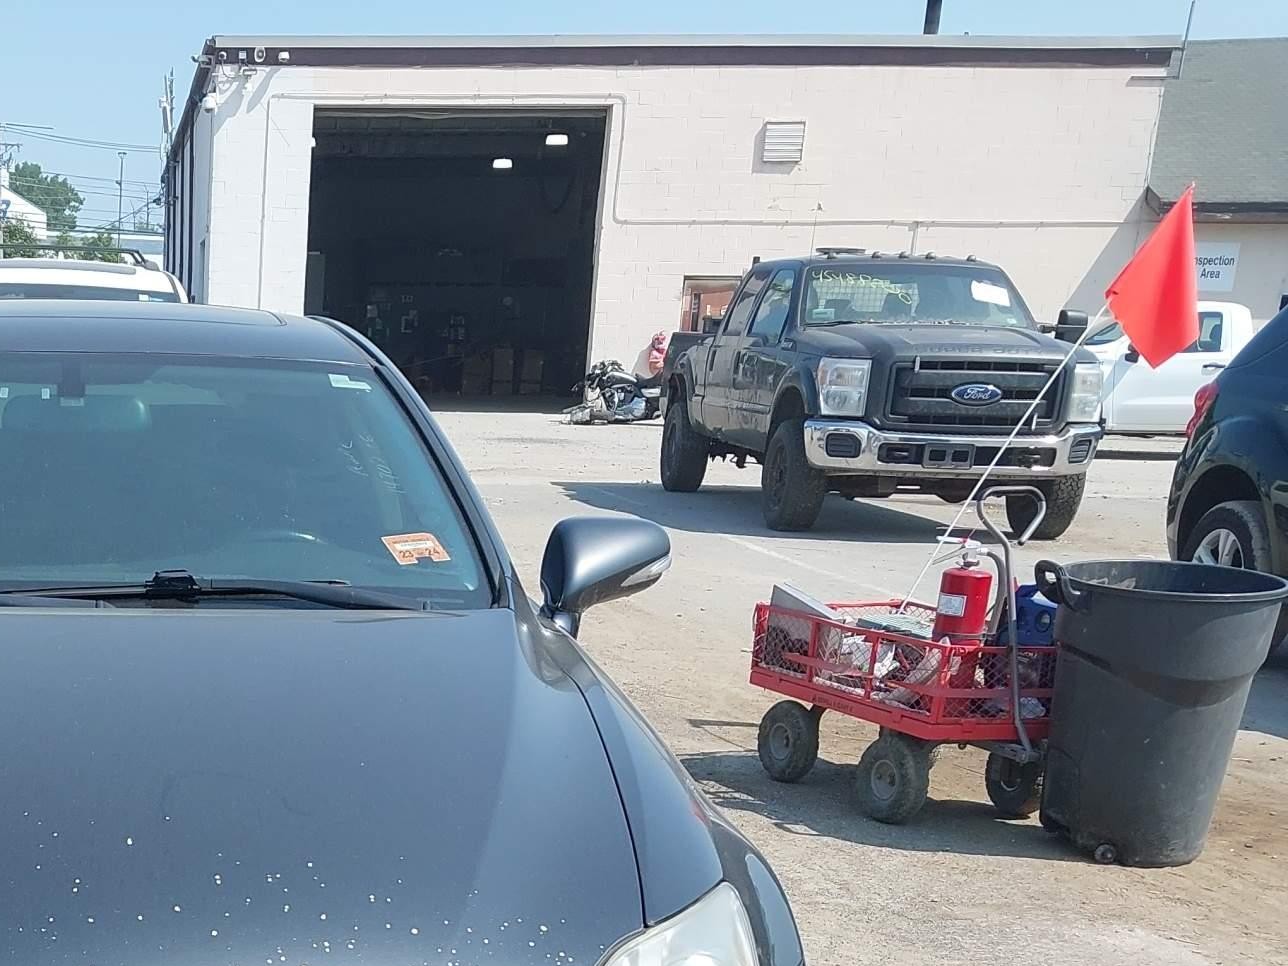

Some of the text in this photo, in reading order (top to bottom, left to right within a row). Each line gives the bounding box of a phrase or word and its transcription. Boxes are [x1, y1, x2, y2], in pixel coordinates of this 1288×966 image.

[1194, 256, 1235, 268] nspection
[1199, 268, 1221, 279] Area
[963, 387, 992, 399] Ford
